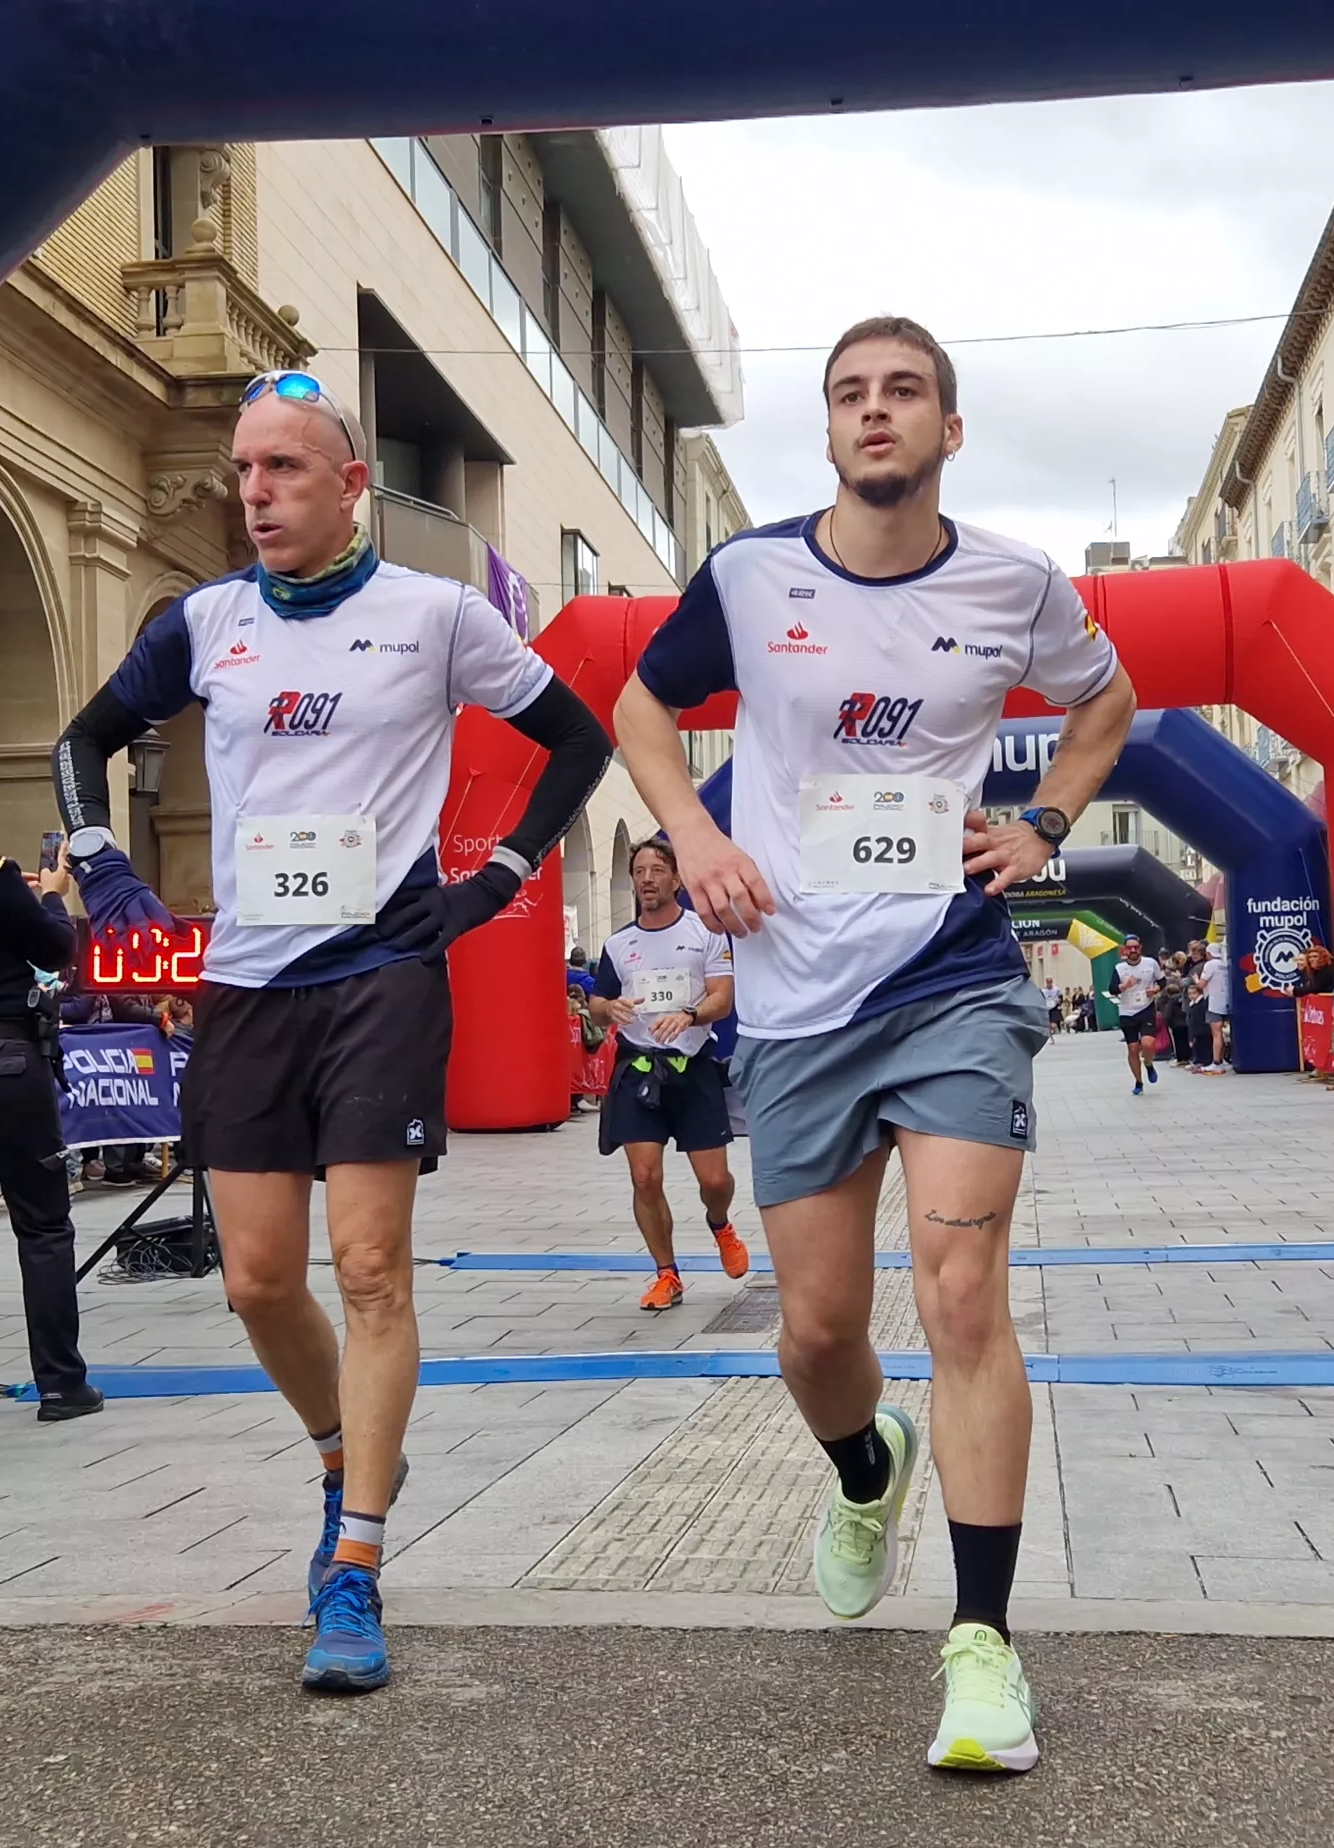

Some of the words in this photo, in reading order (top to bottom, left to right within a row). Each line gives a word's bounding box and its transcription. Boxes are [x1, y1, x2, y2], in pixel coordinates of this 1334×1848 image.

[380, 640, 419, 655] mupol
[768, 641, 829, 655] Santander
[965, 644, 1003, 660] mupol
[453, 835, 503, 856] Sport
[853, 836, 917, 864] 629
[273, 871, 329, 897] 326
[1247, 896, 1320, 913] fundación
[1260, 911, 1307, 929] mupol
[651, 991, 673, 1002] 330
[67, 1078, 159, 1109] NACIONAL
